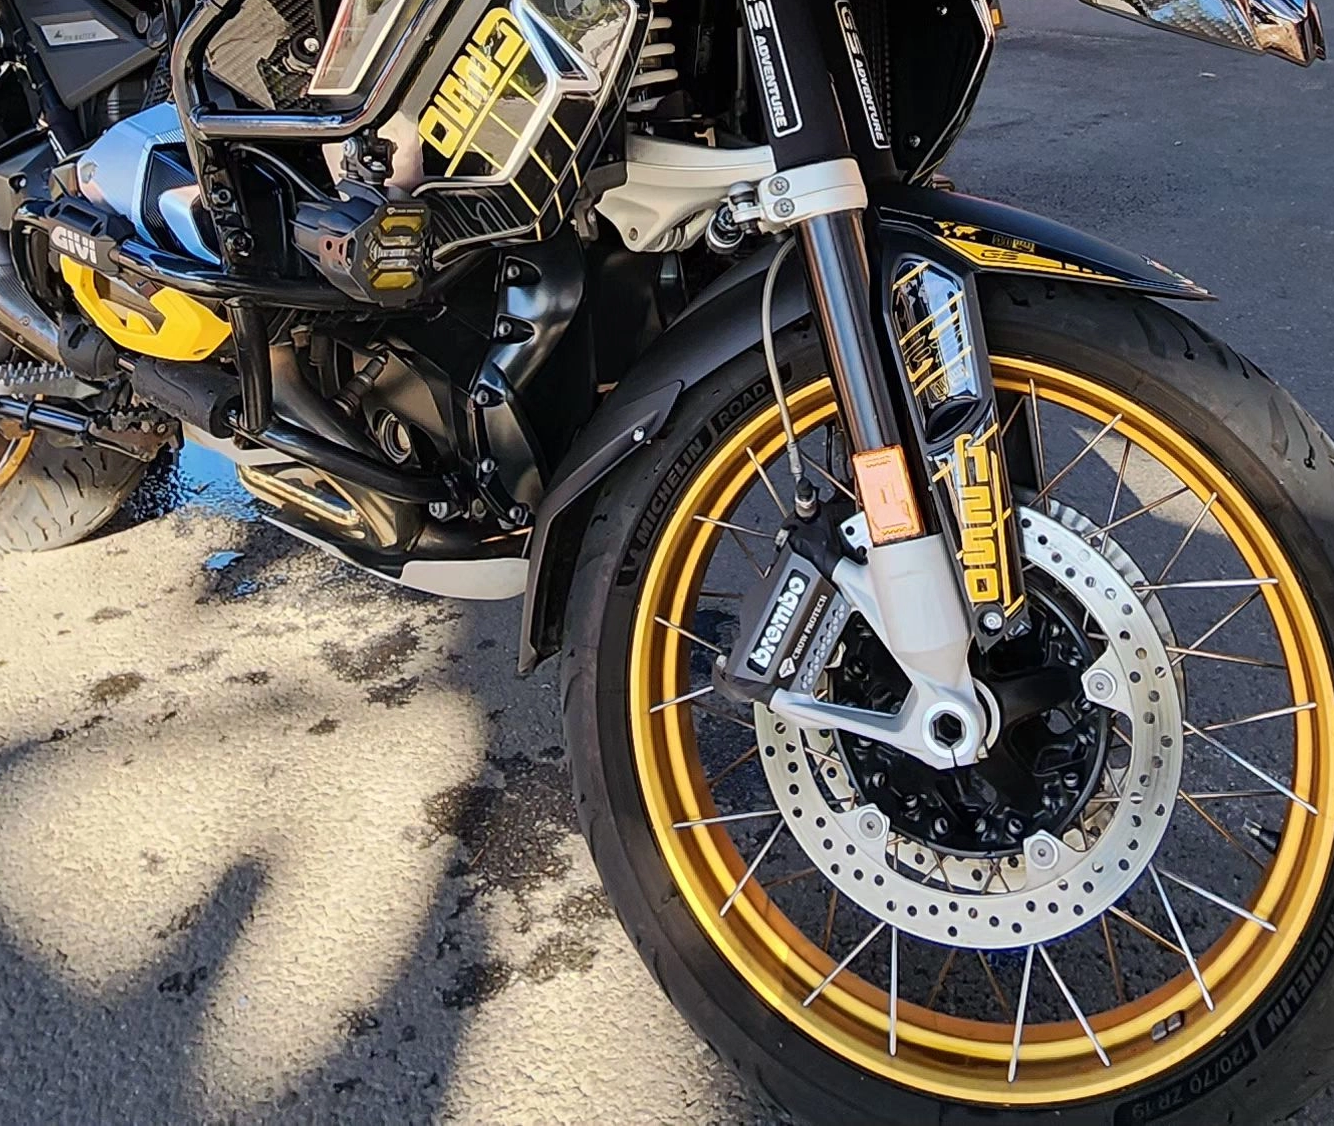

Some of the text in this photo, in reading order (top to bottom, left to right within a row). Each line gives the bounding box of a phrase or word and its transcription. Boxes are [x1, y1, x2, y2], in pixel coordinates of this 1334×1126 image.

[755, 35, 788, 128] ADVENTURE
[841, 6, 884, 142] GS ADVENTURE
[52, 226, 98, 264] GIVI
[980, 250, 1019, 260] GS
[636, 382, 767, 549] MICHELIN ROAD
[750, 577, 805, 668] brembo
[792, 595, 827, 659] CROW PROTECH
[1189, 1042, 1251, 1090] 120/70
